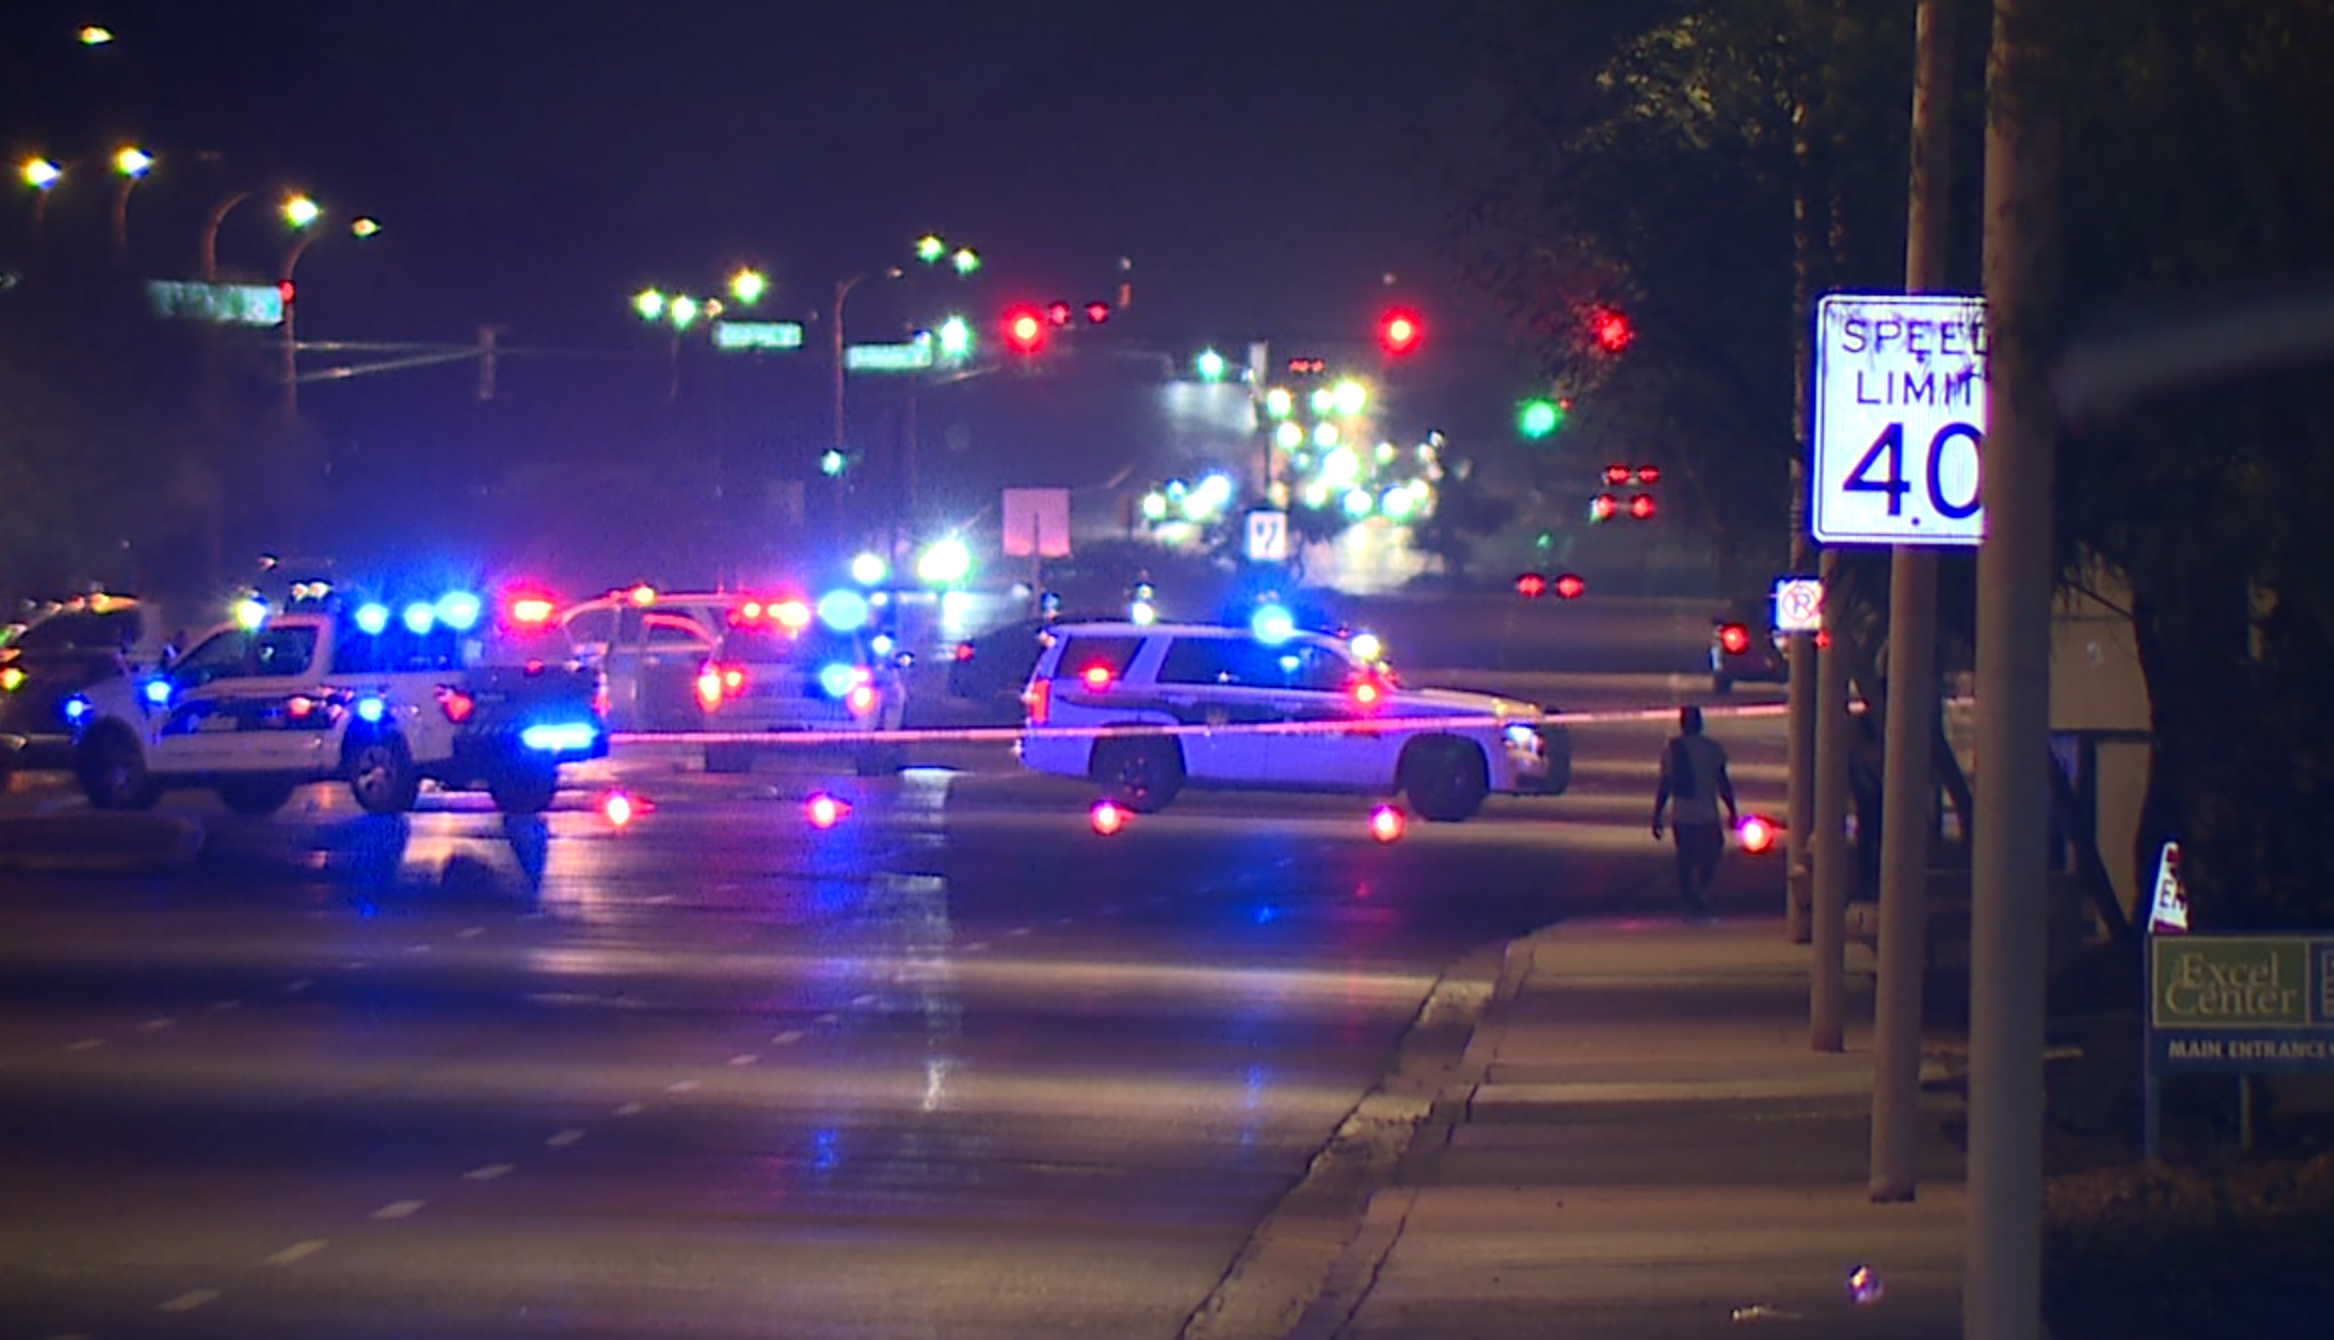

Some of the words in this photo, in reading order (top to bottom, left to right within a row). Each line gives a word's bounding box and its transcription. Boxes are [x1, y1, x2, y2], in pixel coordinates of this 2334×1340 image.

[1843, 421, 1985, 520] 40
[2177, 951, 2279, 988] Excel
[2165, 980, 2298, 1016] Center
[2168, 1039, 2223, 1059] MAIN
[2227, 1039, 2326, 1059] ENTRANCE
